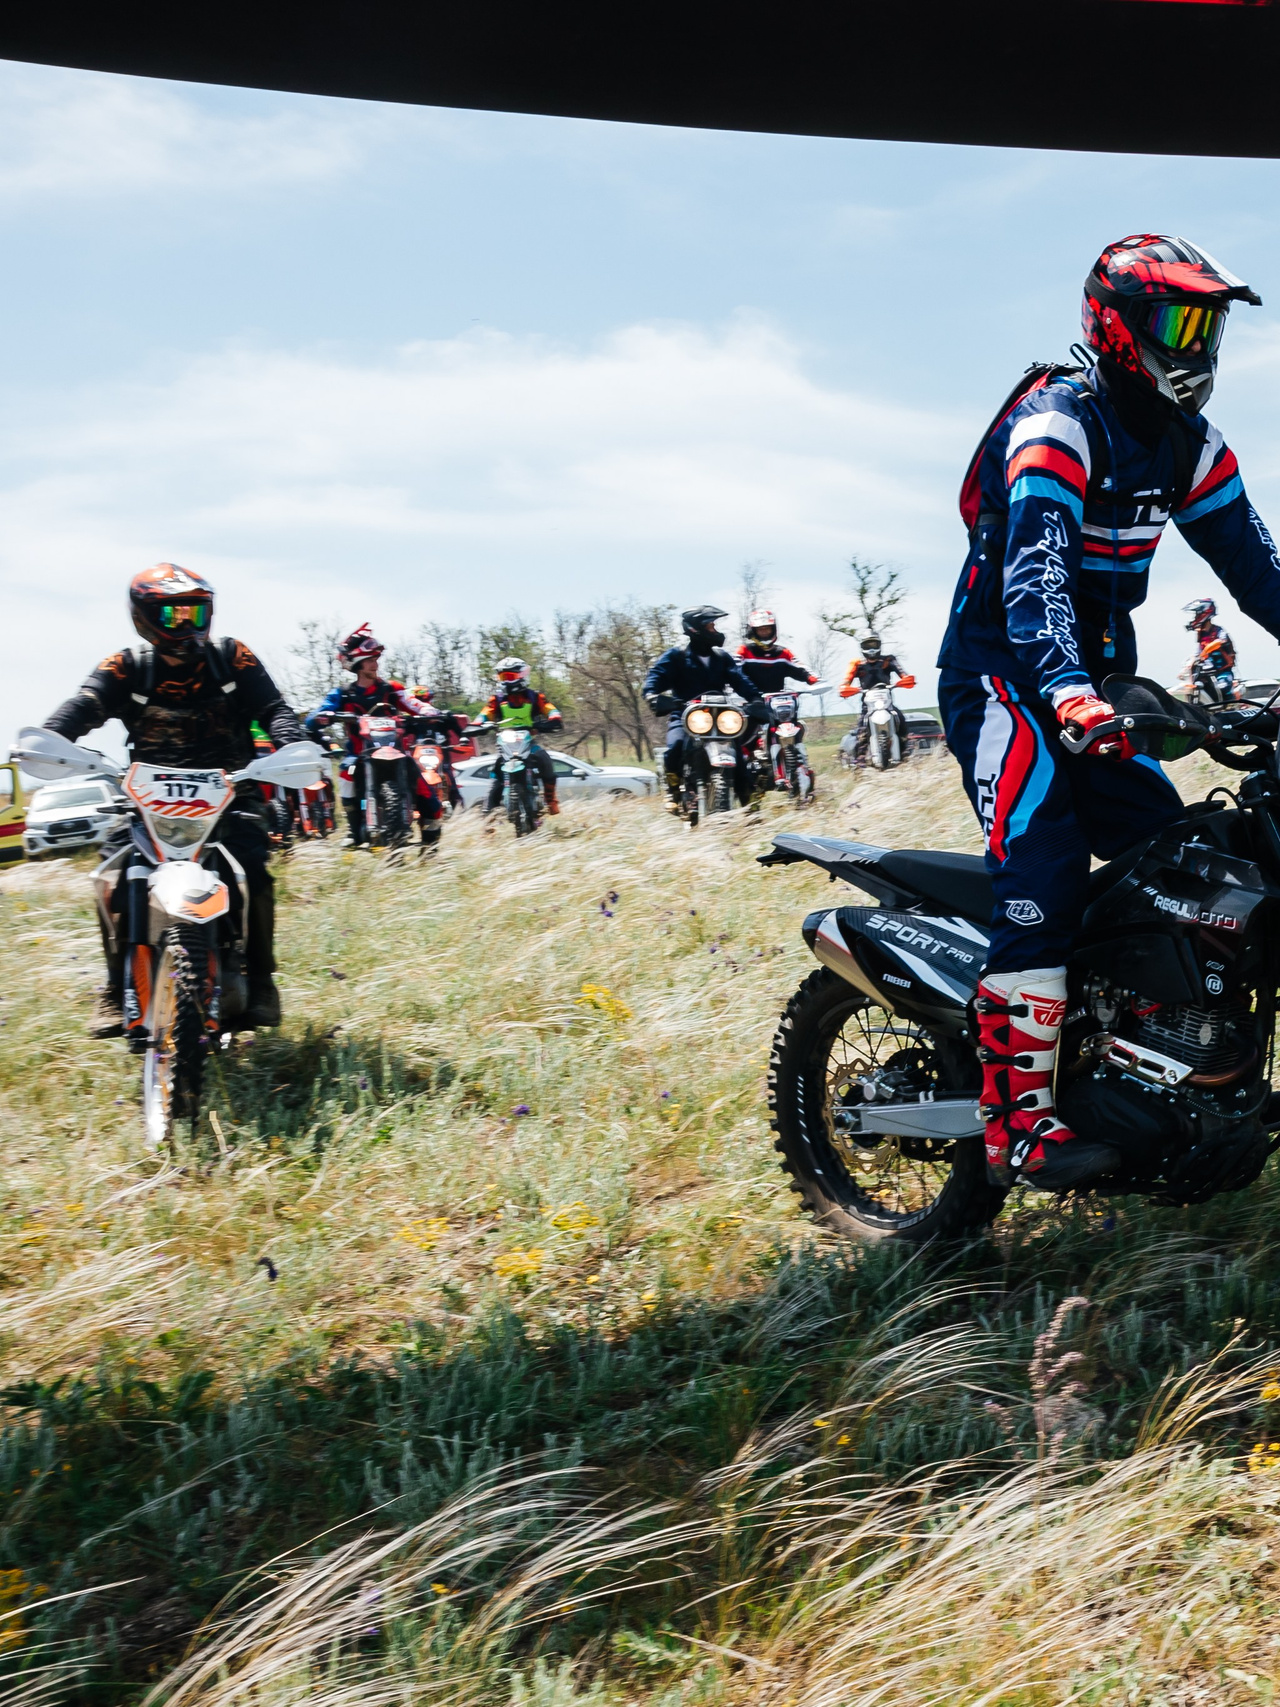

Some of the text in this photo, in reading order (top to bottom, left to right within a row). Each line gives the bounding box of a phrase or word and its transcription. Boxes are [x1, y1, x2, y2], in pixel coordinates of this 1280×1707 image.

[163, 783, 200, 798] 117
[865, 913, 975, 964] SPORT PRO
[882, 973, 912, 989] NIBBI
